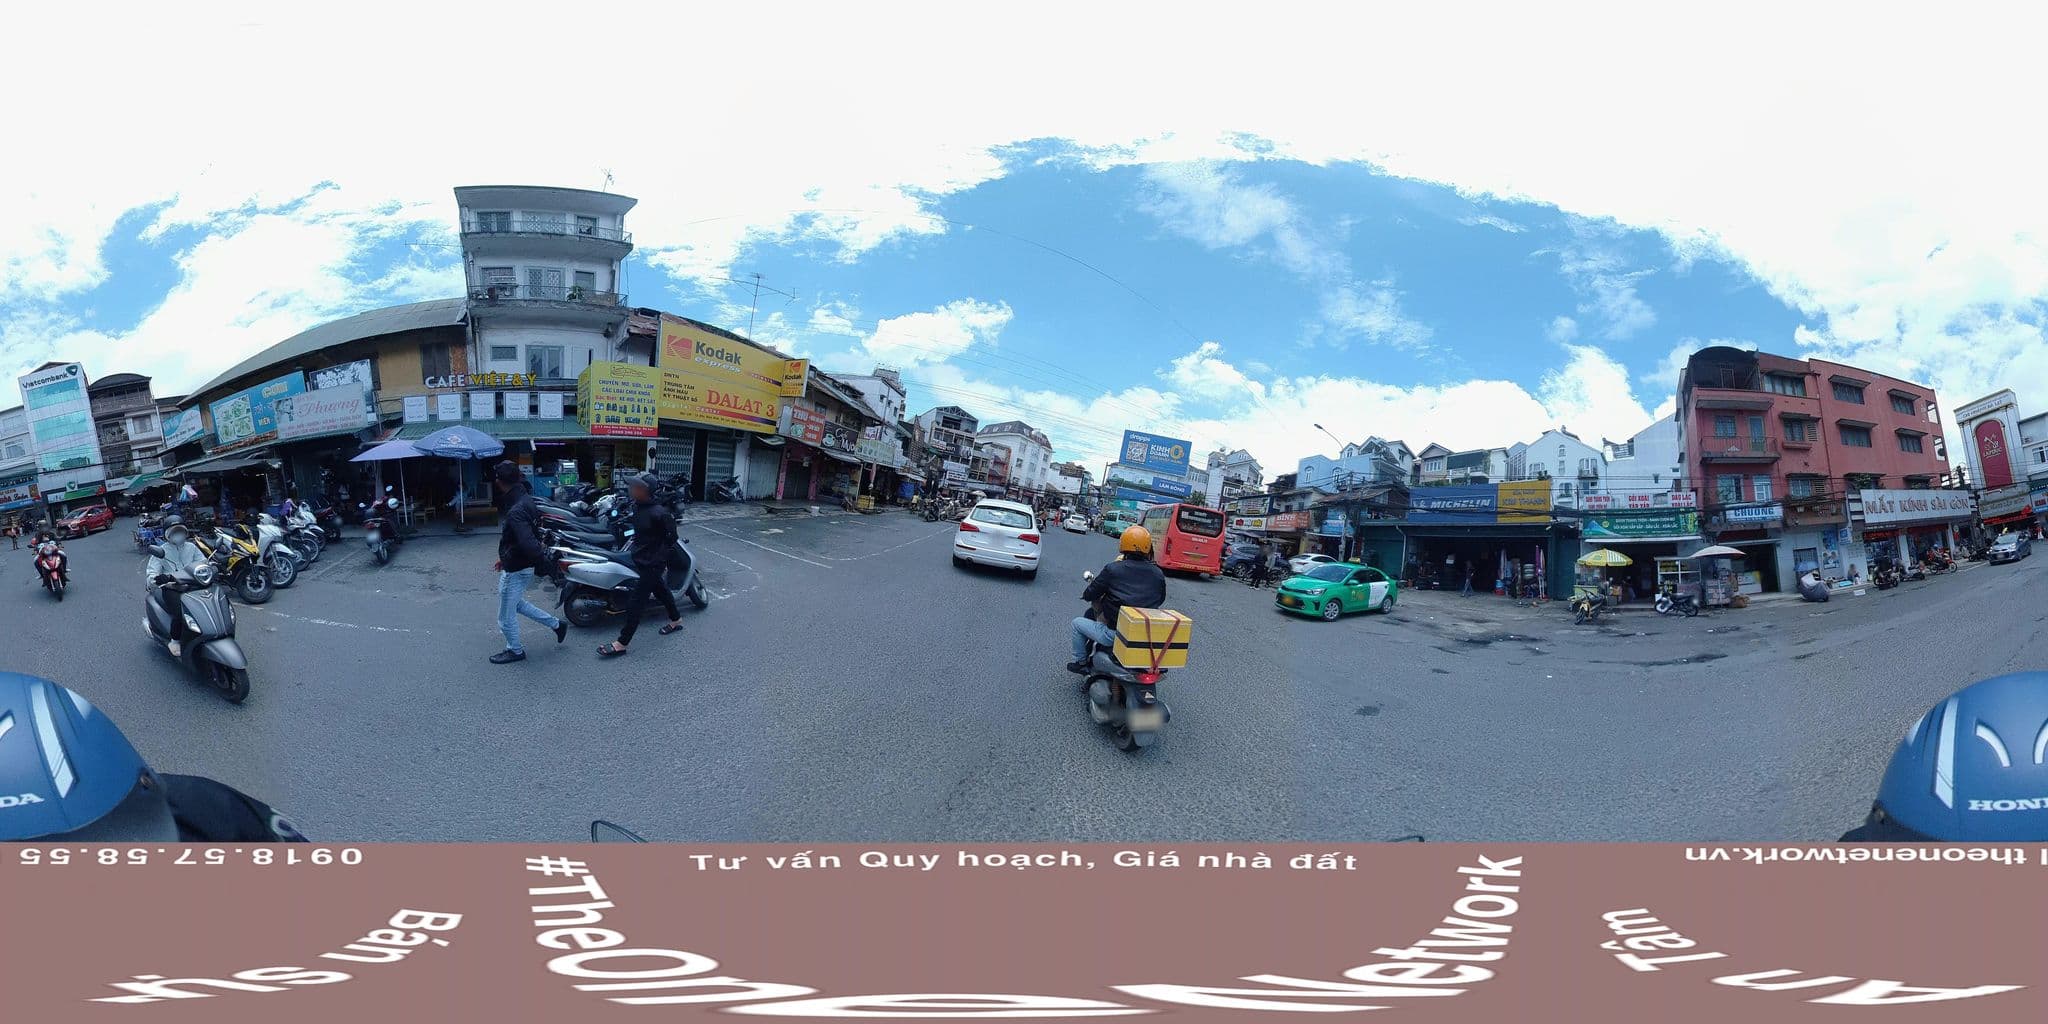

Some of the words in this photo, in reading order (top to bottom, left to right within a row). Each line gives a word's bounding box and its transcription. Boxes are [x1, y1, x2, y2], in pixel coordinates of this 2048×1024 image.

[695, 341, 741, 366] Kodak
[23, 372, 68, 389] Vietcombank
[512, 372, 523, 387] &
[706, 389, 763, 415] DALAT
[766, 404, 775, 417] 3
[1430, 499, 1491, 509] MICHELIN
[1865, 494, 1895, 514] MẮT
